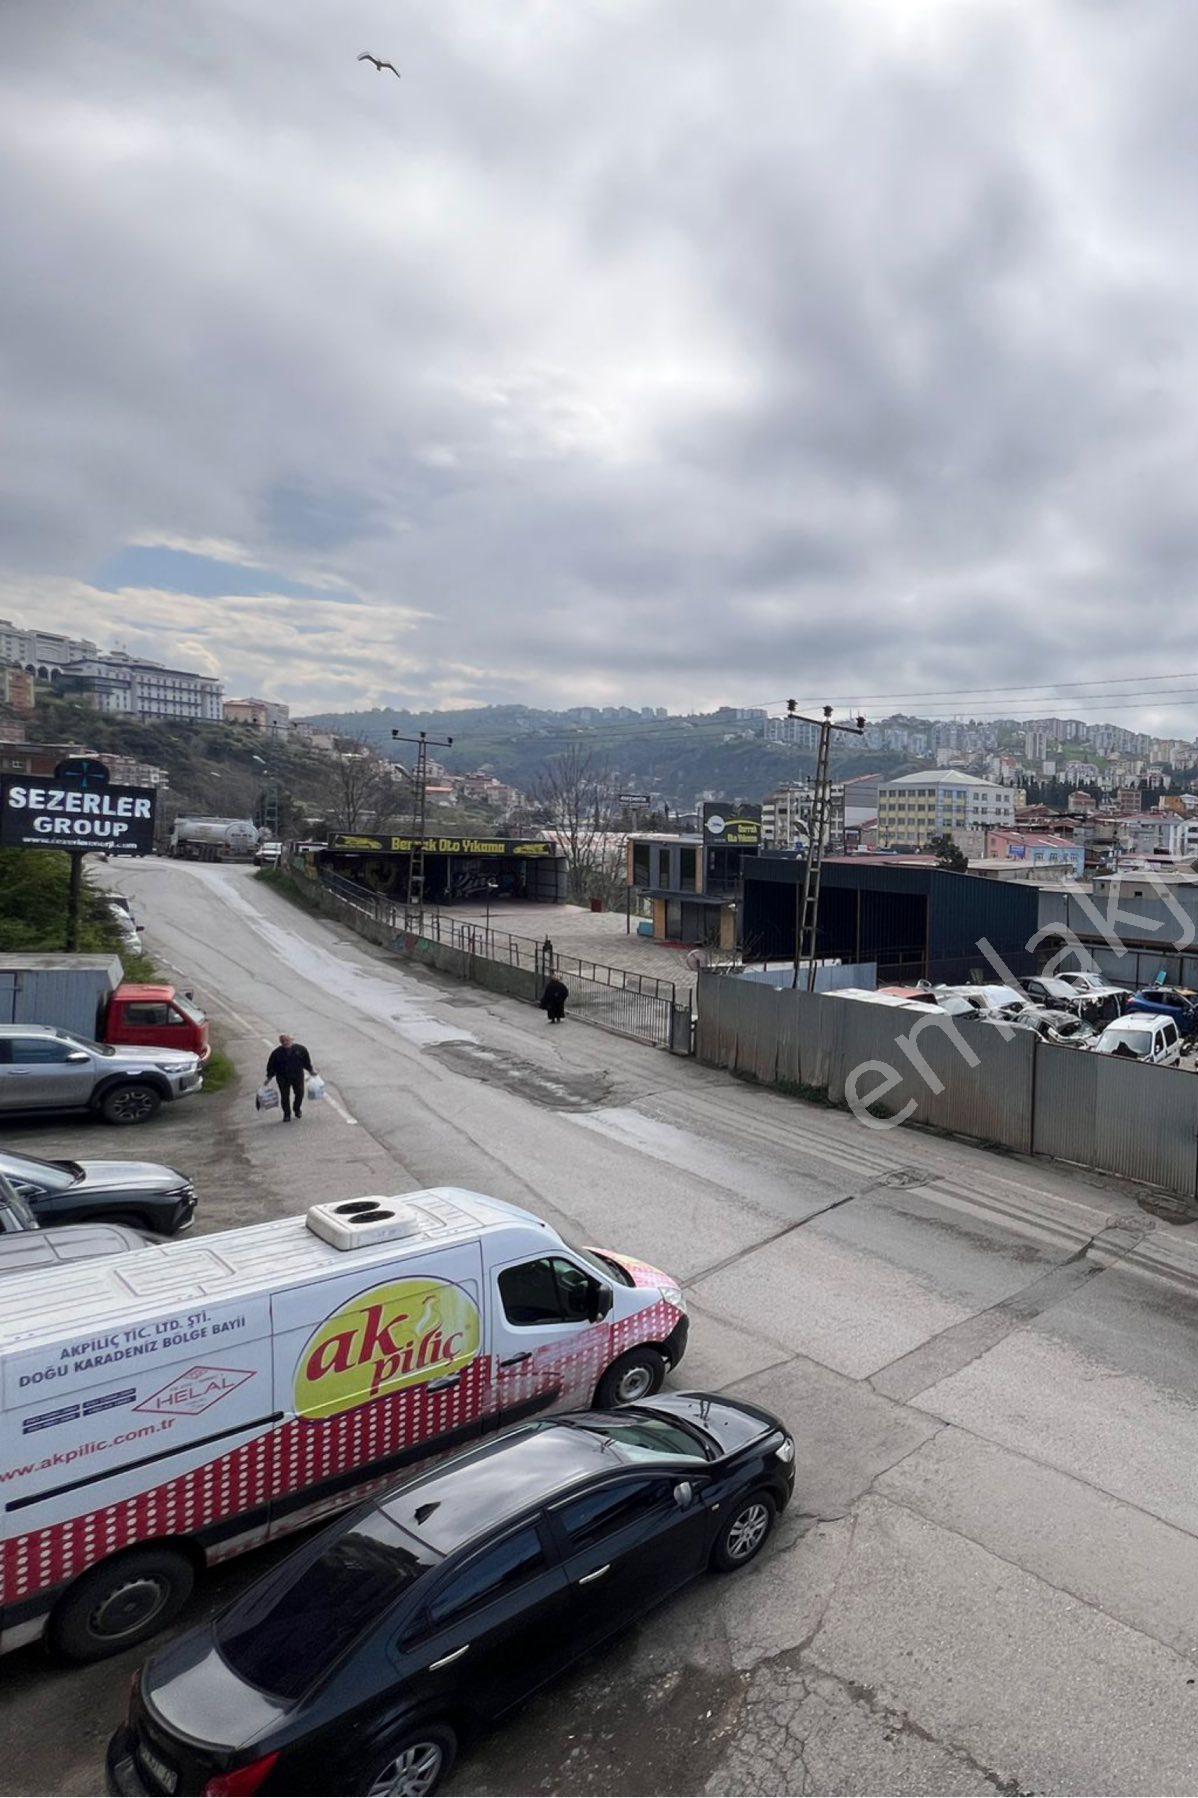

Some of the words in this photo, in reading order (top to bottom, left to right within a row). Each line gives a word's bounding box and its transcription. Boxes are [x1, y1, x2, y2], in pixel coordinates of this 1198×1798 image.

[9, 787, 151, 818] SEZERLER
[33, 817, 128, 837] GROUP
[439, 839, 460, 852] Oto
[155, 1319, 183, 1335] LTD.
[306, 1304, 409, 1381] ak
[370, 1321, 463, 1397] piliç
[19, 1364, 68, 1387] DOĞU
[156, 1378, 235, 1409] HELAL
